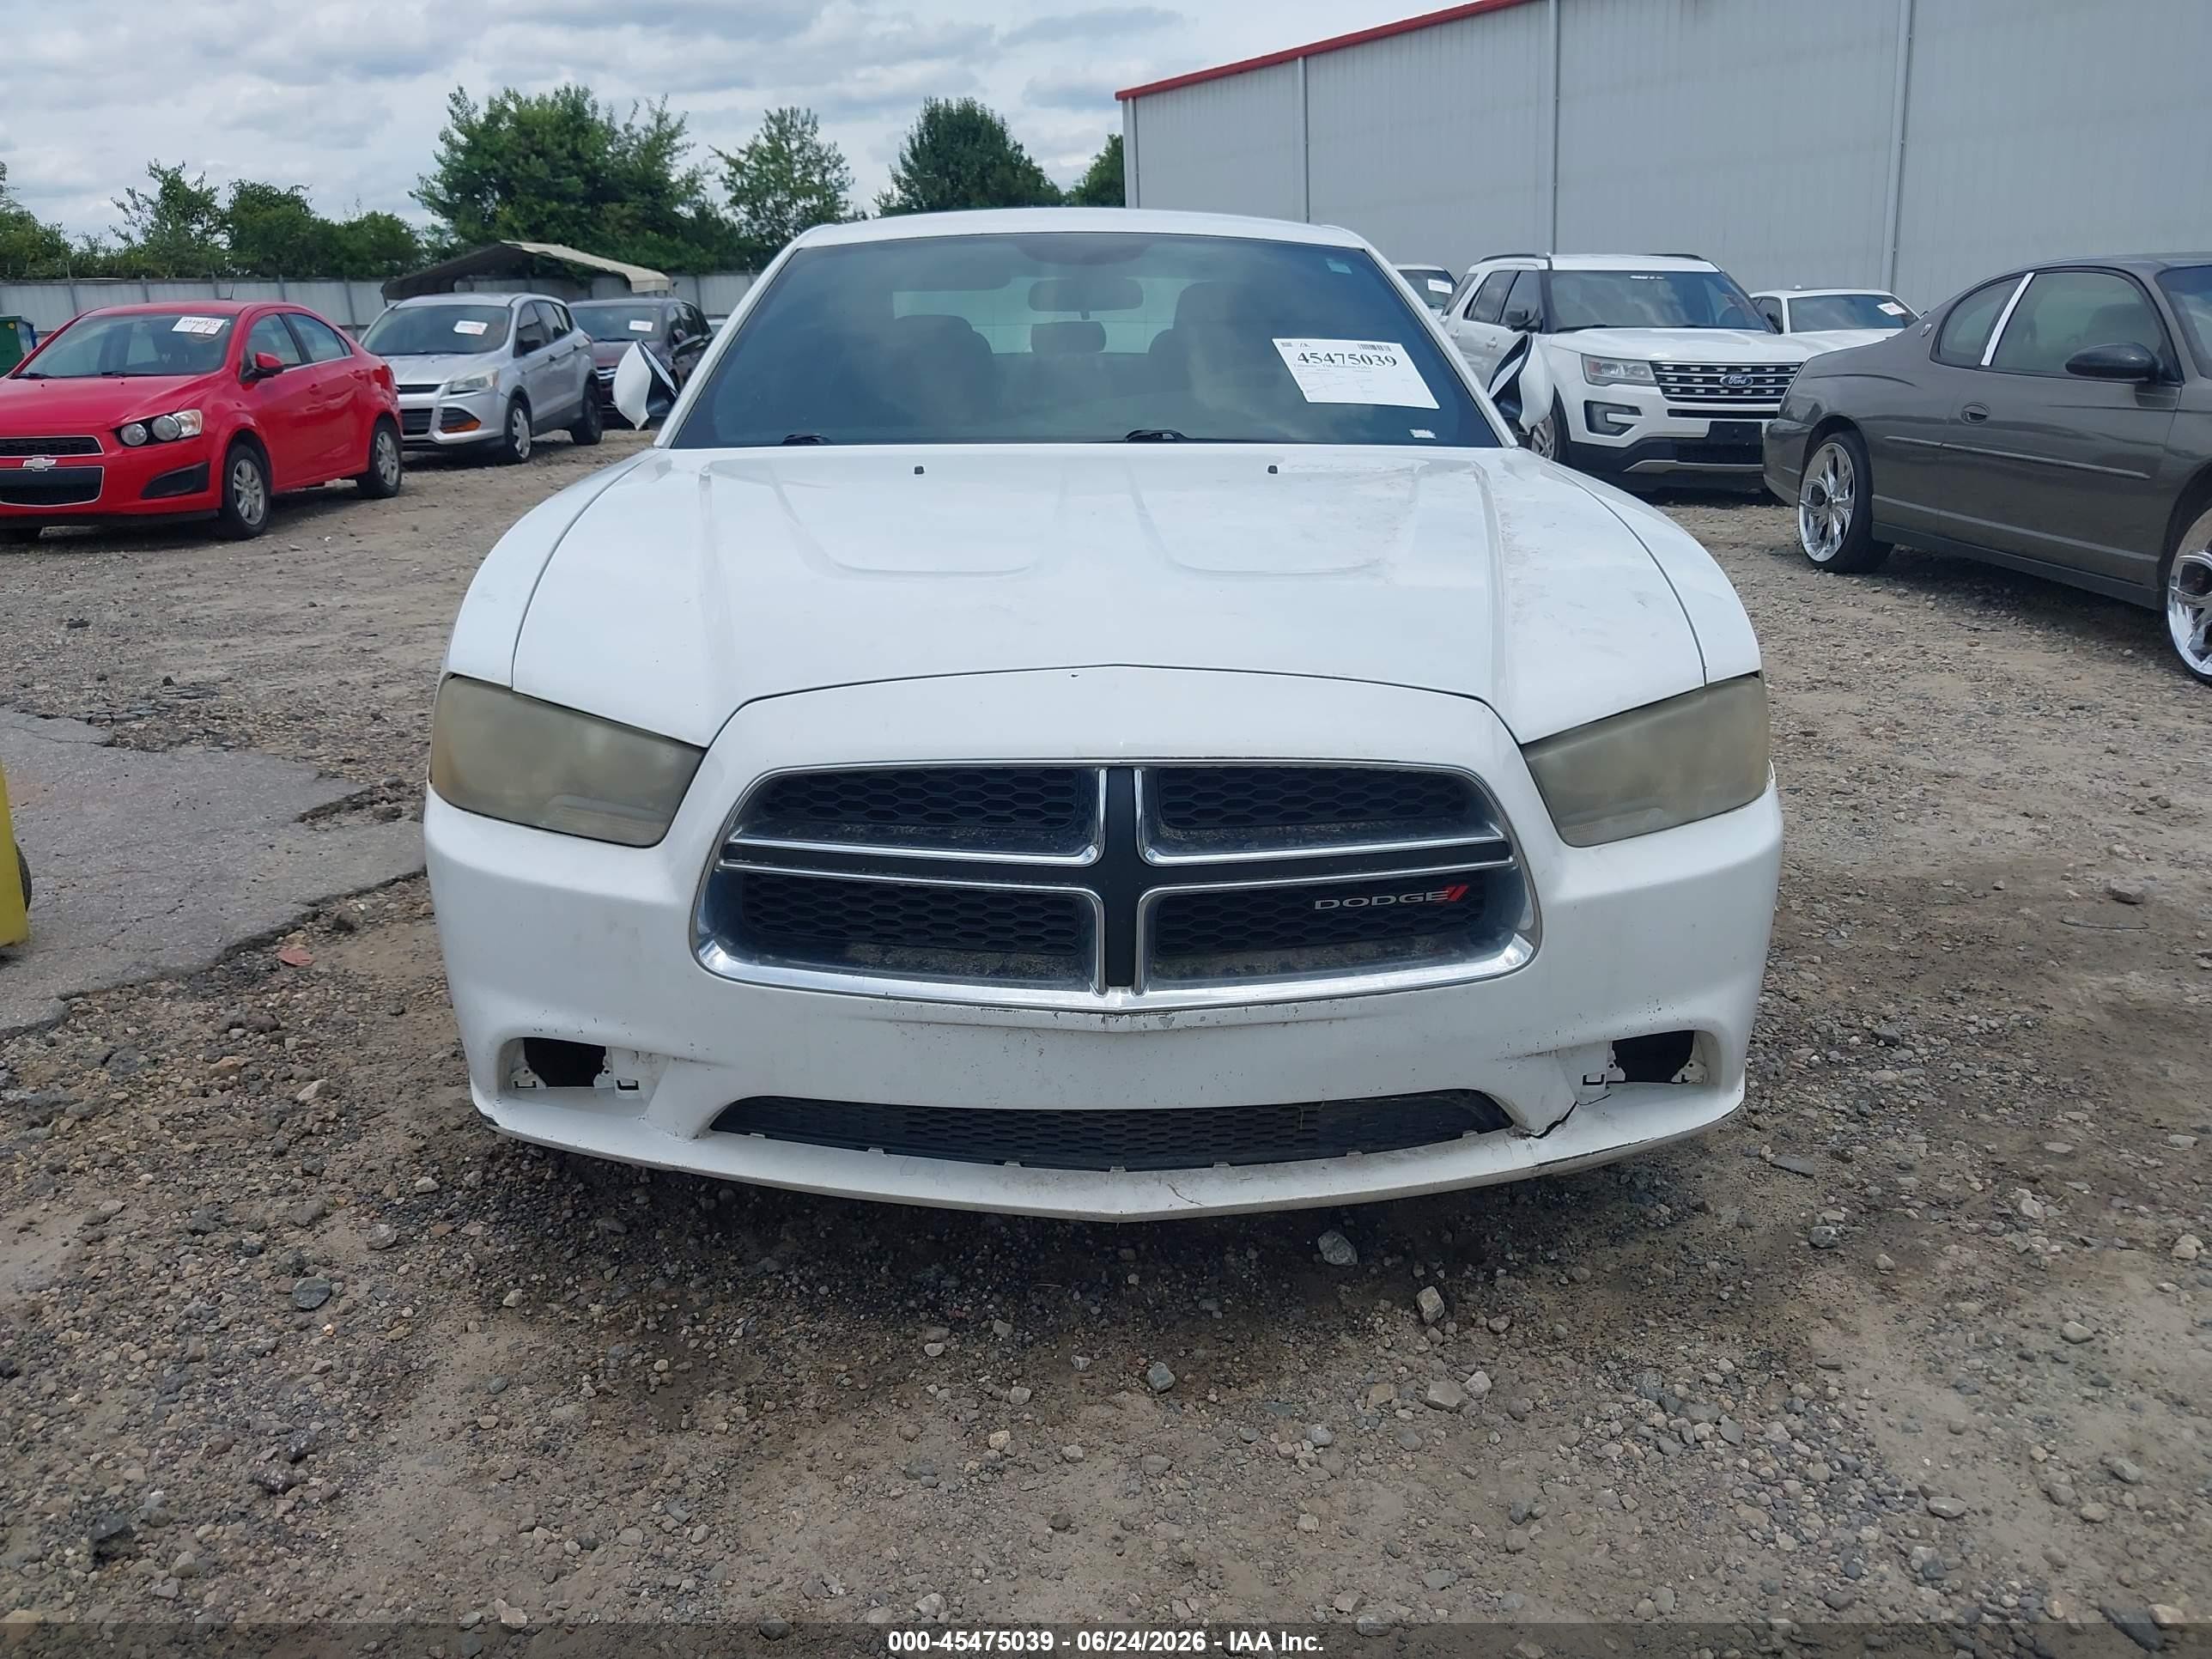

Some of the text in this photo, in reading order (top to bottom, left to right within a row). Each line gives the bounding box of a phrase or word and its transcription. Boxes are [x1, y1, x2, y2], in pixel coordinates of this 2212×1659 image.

[1297, 352, 1397, 368] 45475039
[1728, 375, 1747, 385] Ford
[1314, 890, 1449, 910] DODGE
